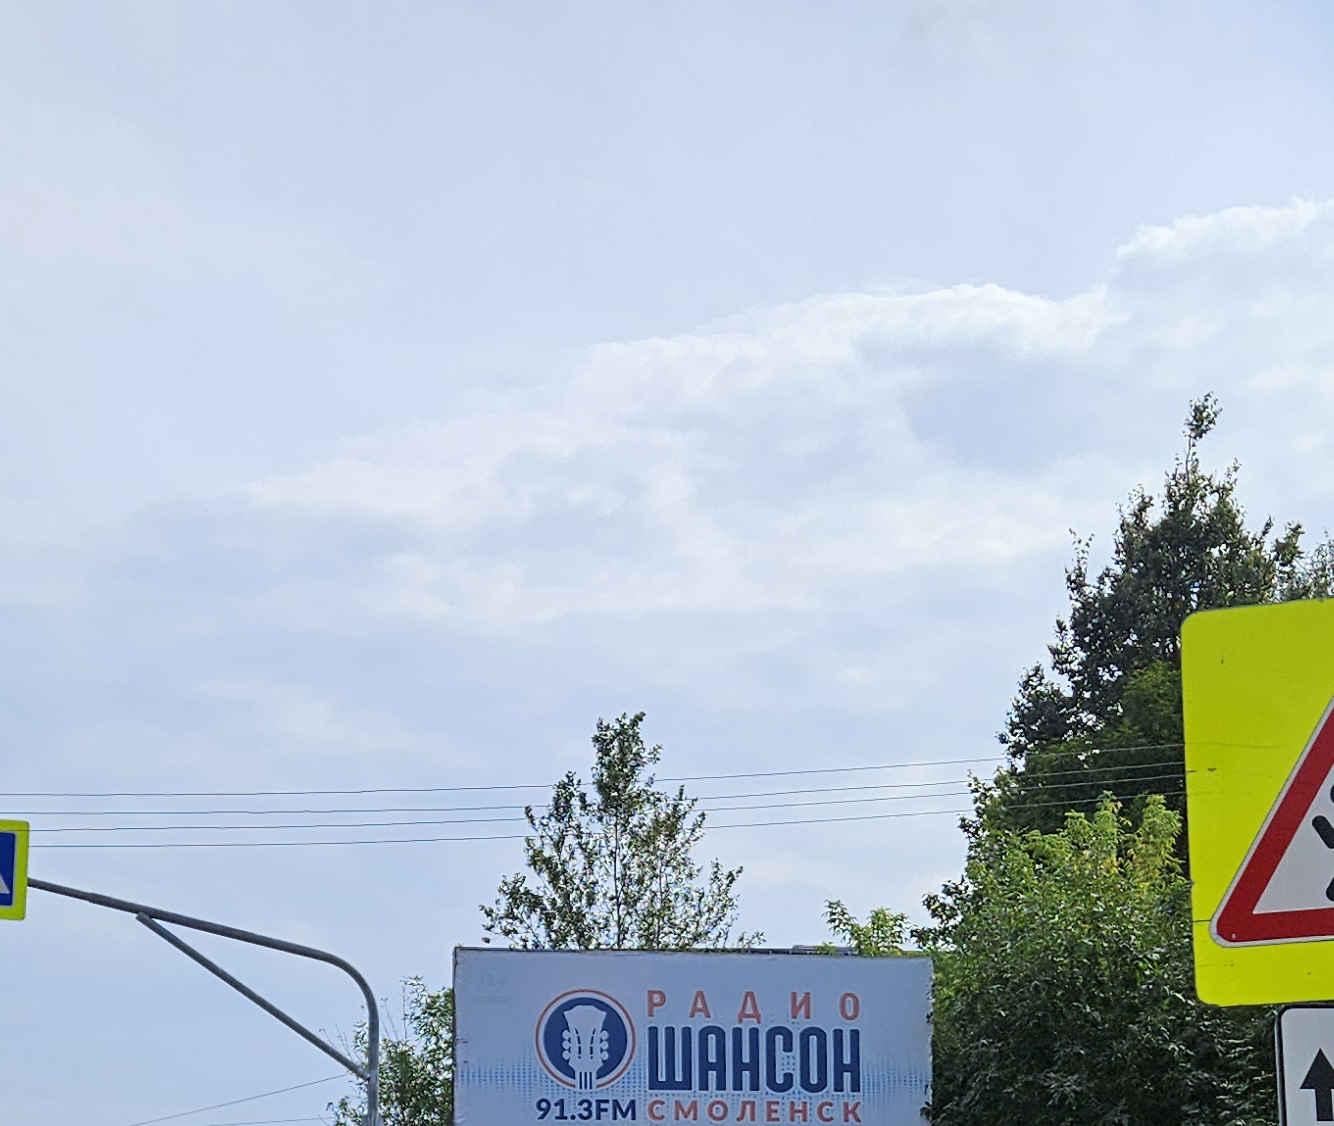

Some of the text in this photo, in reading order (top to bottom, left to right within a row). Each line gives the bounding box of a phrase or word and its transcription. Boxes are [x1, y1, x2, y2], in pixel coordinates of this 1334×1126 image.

[647, 990, 859, 1024] РАДИО
[648, 1026, 860, 1093] ШАНСОН
[535, 1099, 637, 1121] 91.3FM
[647, 1100, 862, 1122] СМОЛЕНСК
